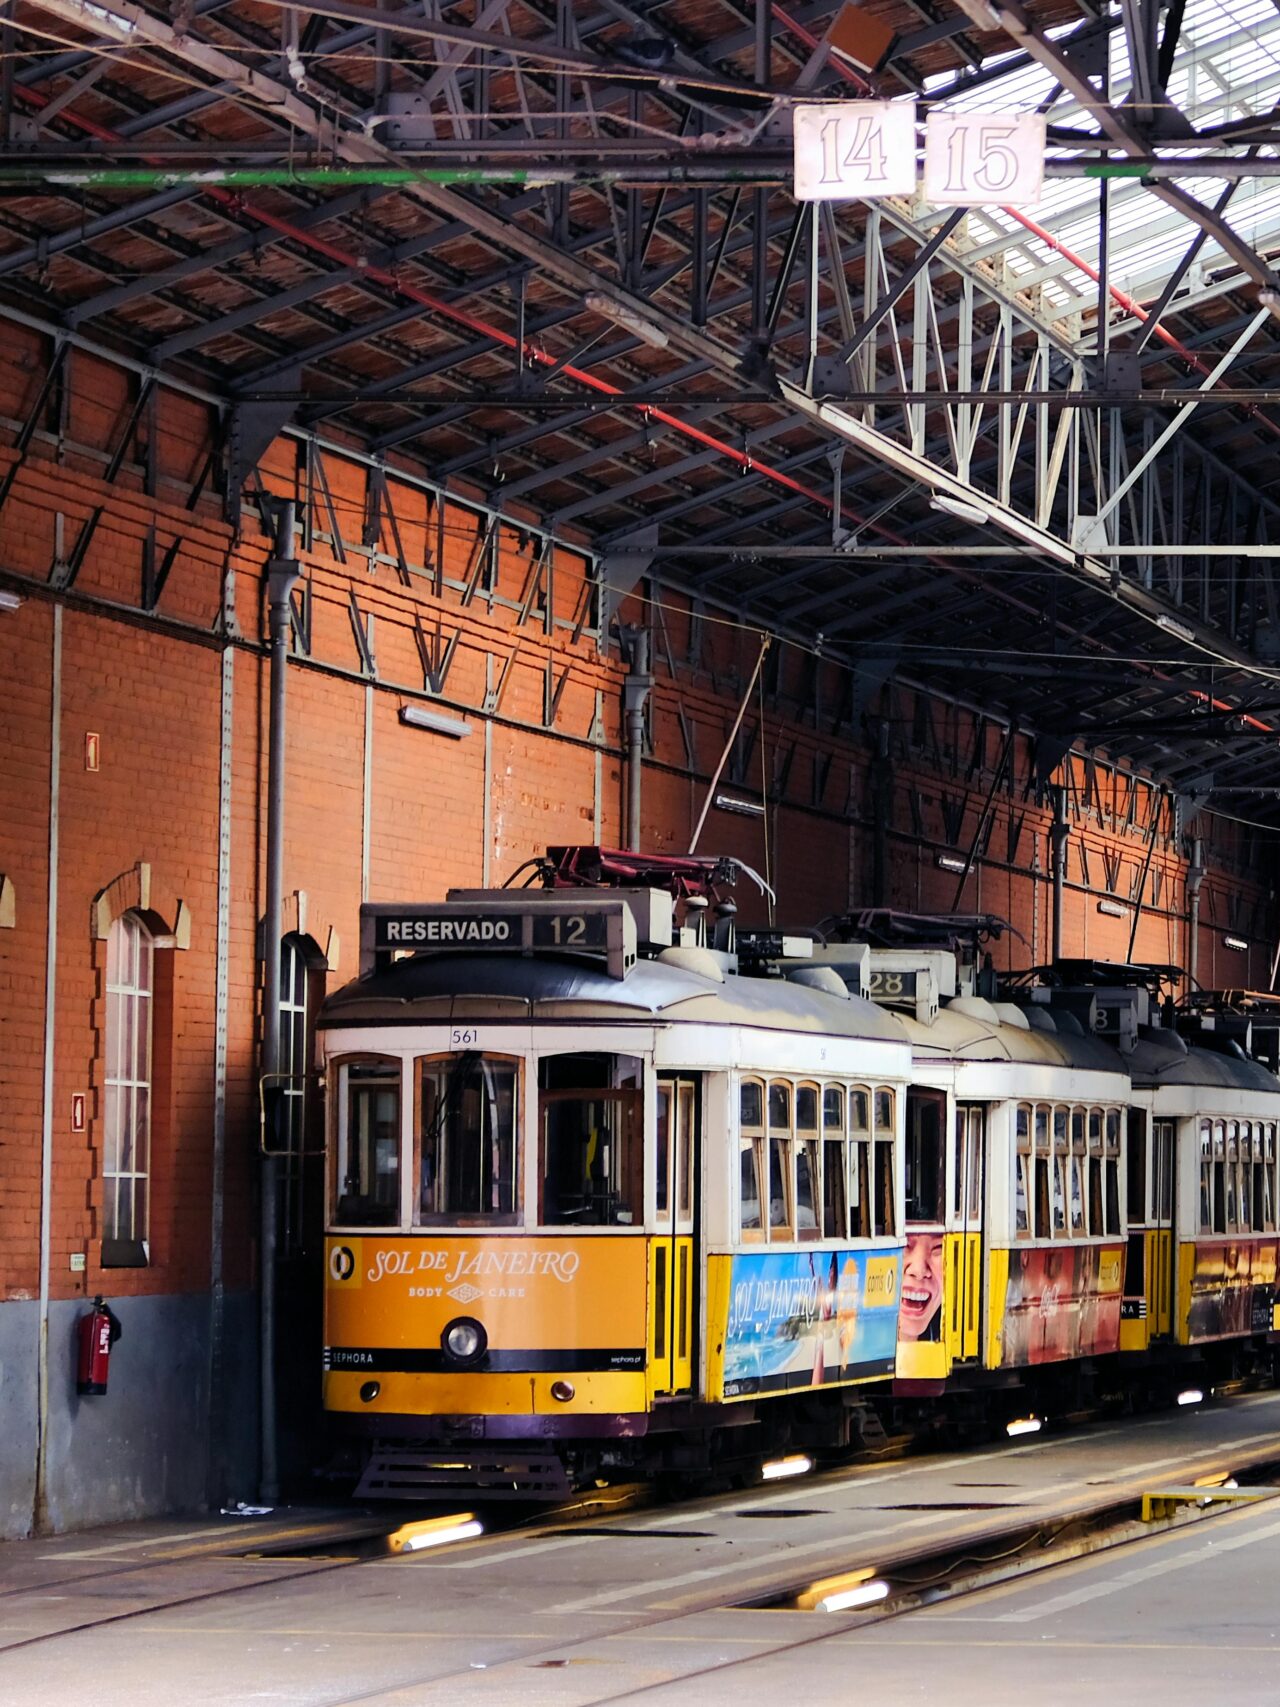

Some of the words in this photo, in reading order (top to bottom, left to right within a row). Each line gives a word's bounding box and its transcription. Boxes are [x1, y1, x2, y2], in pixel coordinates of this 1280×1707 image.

[819, 116, 888, 184] 14
[942, 126, 1019, 192] 15
[387, 921, 510, 941] RESERVADO
[550, 916, 587, 945] 12
[868, 971, 904, 994] 28
[452, 1029, 478, 1044] 561
[367, 1250, 415, 1282] SOL
[416, 1251, 448, 1270] DE
[445, 1250, 580, 1283] JANEIRO
[408, 1287, 443, 1298] BODY
[488, 1287, 526, 1298] CARE
[728, 1281, 754, 1338] SOL
[754, 1281, 770, 1312] DE
[763, 1277, 818, 1334] JANEIRO
[332, 1353, 374, 1364] SEPHORA
